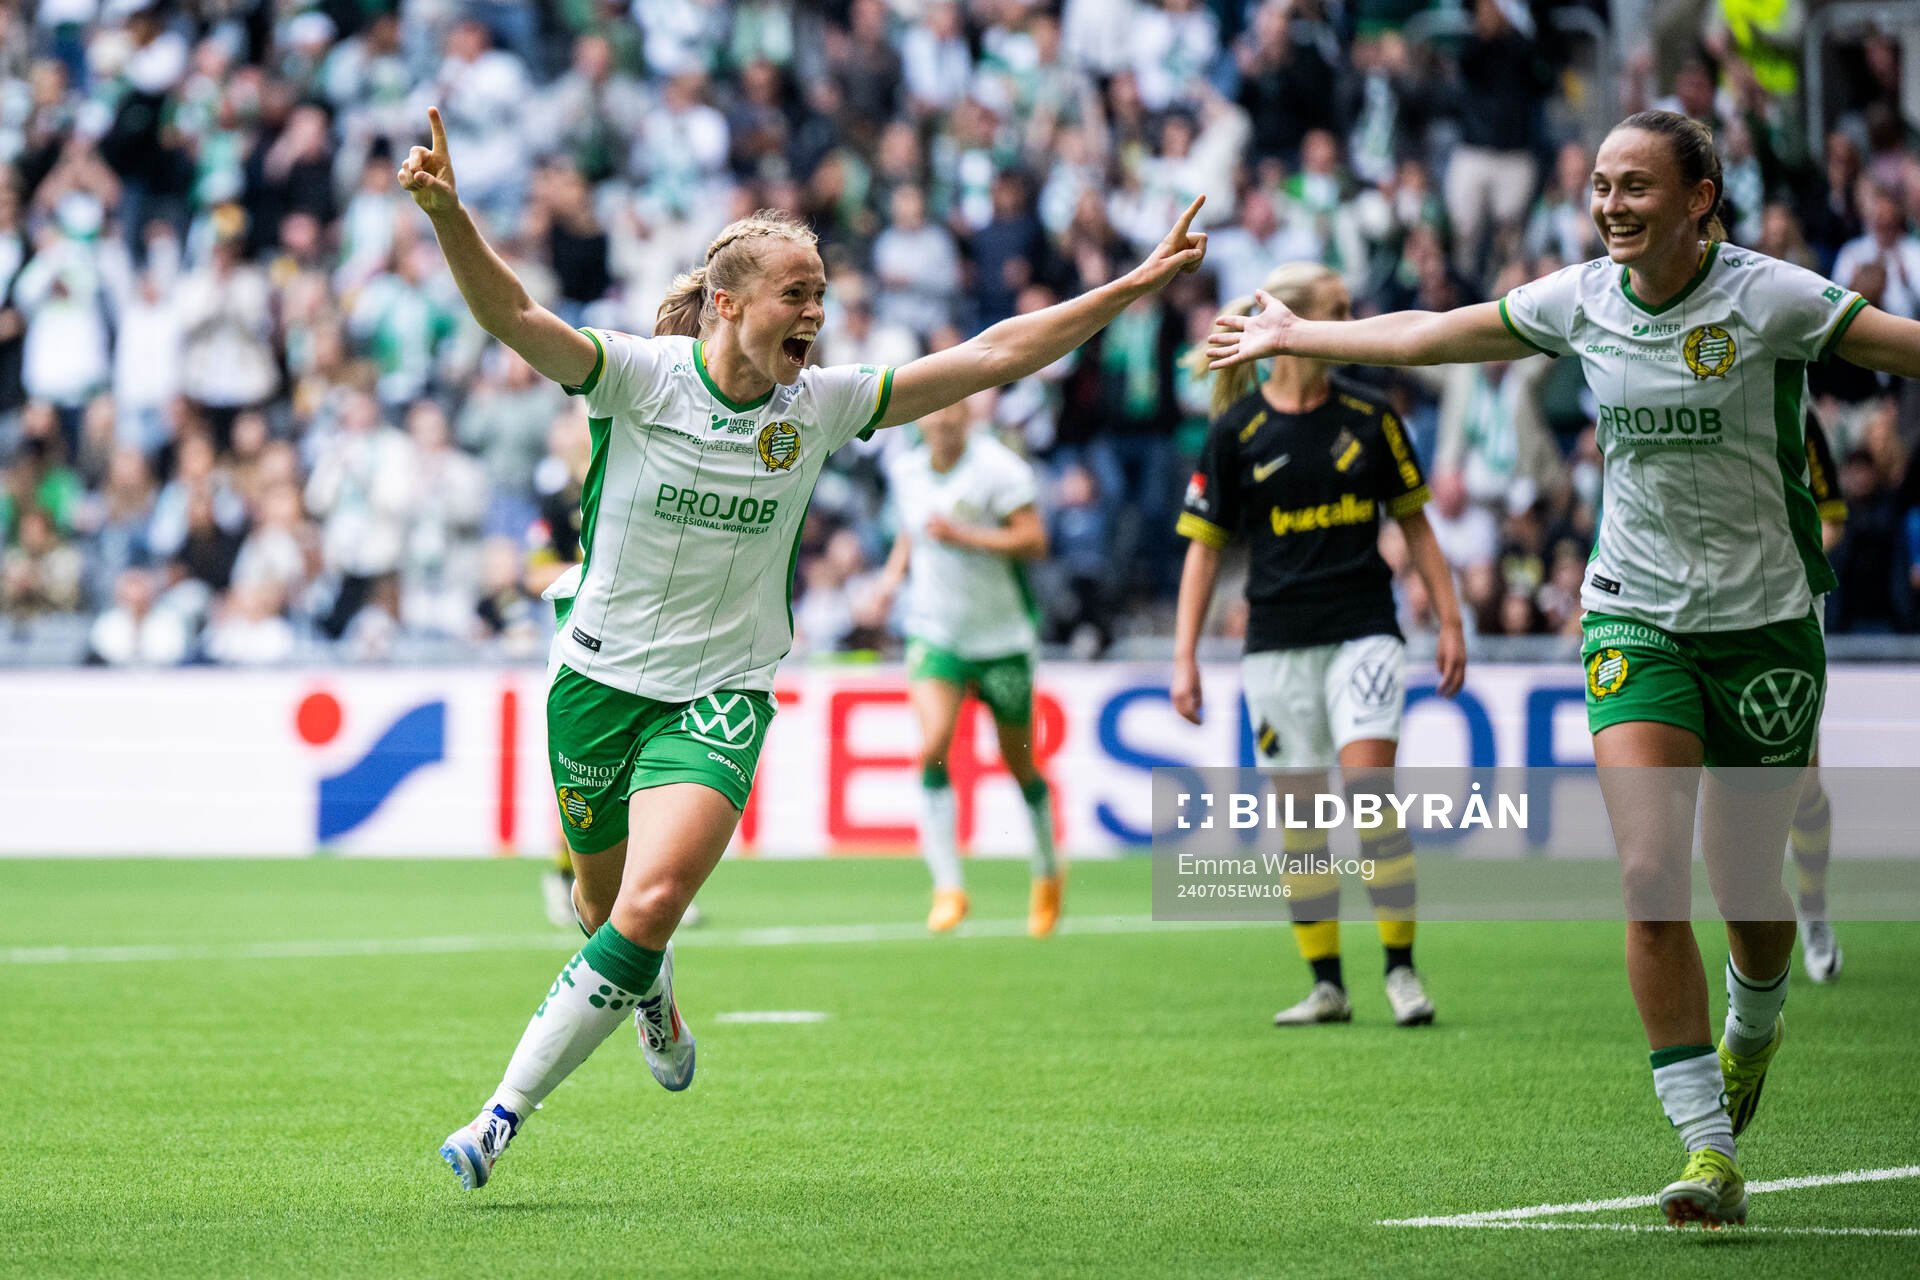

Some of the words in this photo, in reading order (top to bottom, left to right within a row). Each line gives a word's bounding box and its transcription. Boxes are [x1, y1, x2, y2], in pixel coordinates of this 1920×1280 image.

[1651, 323, 1681, 334] INTER
[1585, 344, 1616, 354] CRAFT
[728, 417, 756, 428] INTER
[1600, 404, 1722, 434] PROJOB
[726, 426, 755, 436] SPORT
[1667, 435, 1723, 446] WORKWEAR
[706, 444, 754, 454] WELLNESS
[656, 483, 779, 524] PROJOB
[654, 510, 721, 531] PROFESSIONAL
[707, 752, 742, 776] CRAFT
